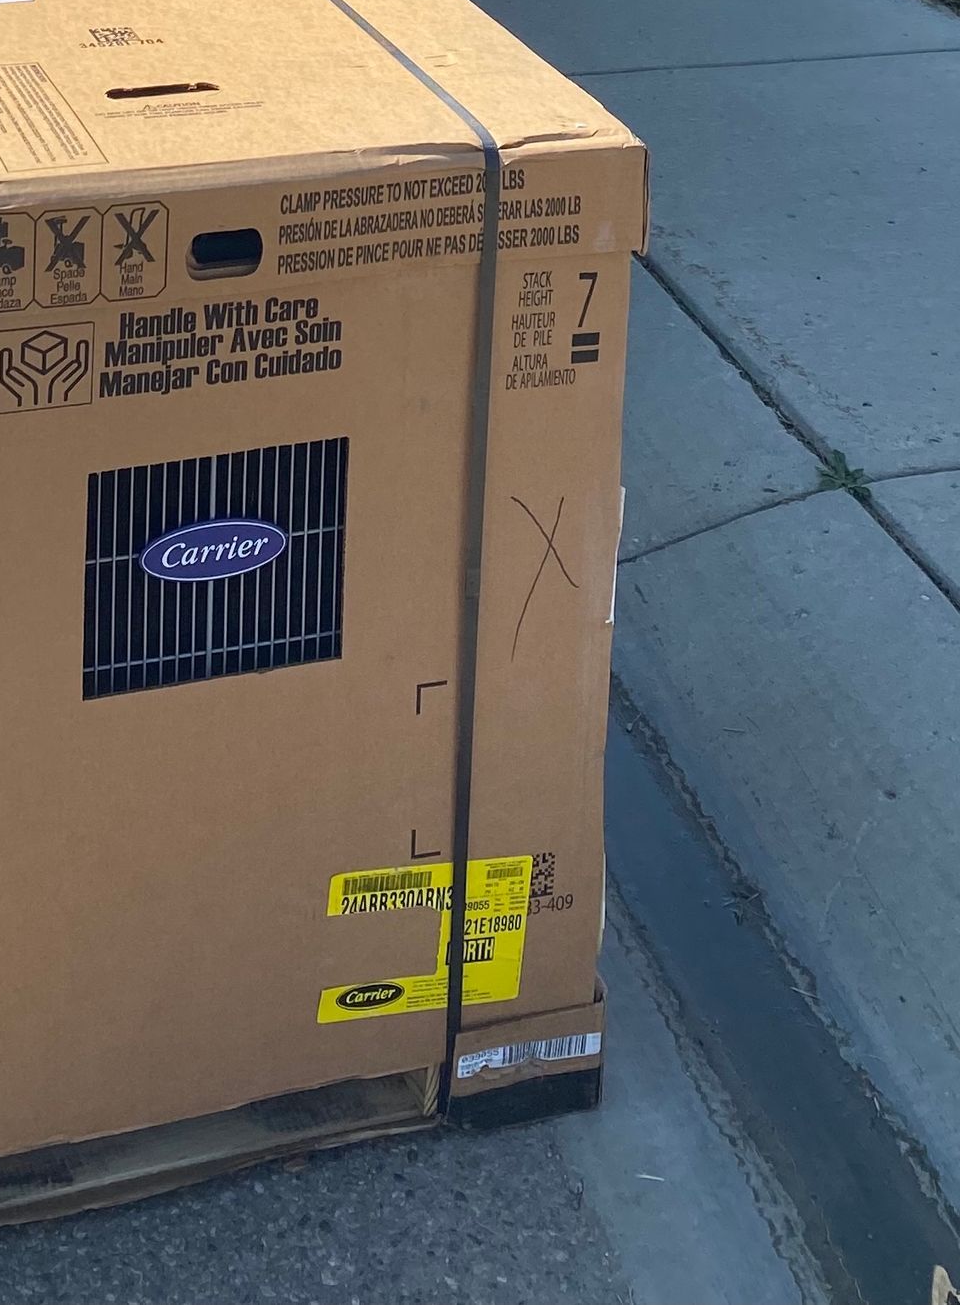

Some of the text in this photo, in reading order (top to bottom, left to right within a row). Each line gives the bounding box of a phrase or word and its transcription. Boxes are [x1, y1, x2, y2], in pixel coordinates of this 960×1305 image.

[280, 193, 321, 215] CLAMP
[323, 185, 384, 210] PRESSURE
[386, 182, 402, 201] TO
[404, 179, 428, 200] NOT
[430, 174, 474, 197] EXCEED
[502, 169, 525, 190] LBS
[279, 216, 321, 245] PRESIÓN
[324, 220, 338, 238] DE
[340, 218, 352, 236] LA
[353, 208, 418, 236] ABRAZADERA
[420, 207, 434, 227] NO
[436, 199, 475, 226] DEBERÁ
[524, 198, 543, 218] LAS
[545, 197, 566, 217] 2000
[277, 250, 335, 275] PRESSION
[338, 247, 353, 267] DE
[355, 243, 390, 264] PINCE
[392, 239, 424, 260] POUR
[426, 236, 440, 256] NE
[441, 234, 467, 255] PAS
[530, 226, 555, 247] 2000
[557, 224, 579, 245] LBS
[53, 268, 85, 281] Spade
[120, 262, 143, 273] Hand
[121, 274, 143, 285] Main
[522, 271, 552, 289] STACK
[50, 293, 87, 305] Espada
[119, 286, 144, 297] Mano
[519, 289, 554, 308] HEIGHT
[578, 271, 598, 327] 7
[120, 296, 319, 340] Handle With Care
[512, 312, 556, 331] HAUTEUR
[104, 319, 342, 368] Manipuler Avec Soin
[514, 330, 552, 348] DE PILE
[99, 346, 342, 398] Manejar Con Cuidado
[512, 354, 548, 372] ALTURA
[505, 368, 576, 390] DE APILAMIENTO
[161, 535, 269, 569] Carrier
[464, 914, 522, 936] 21E18980
[345, 988, 396, 1005] Carrier
